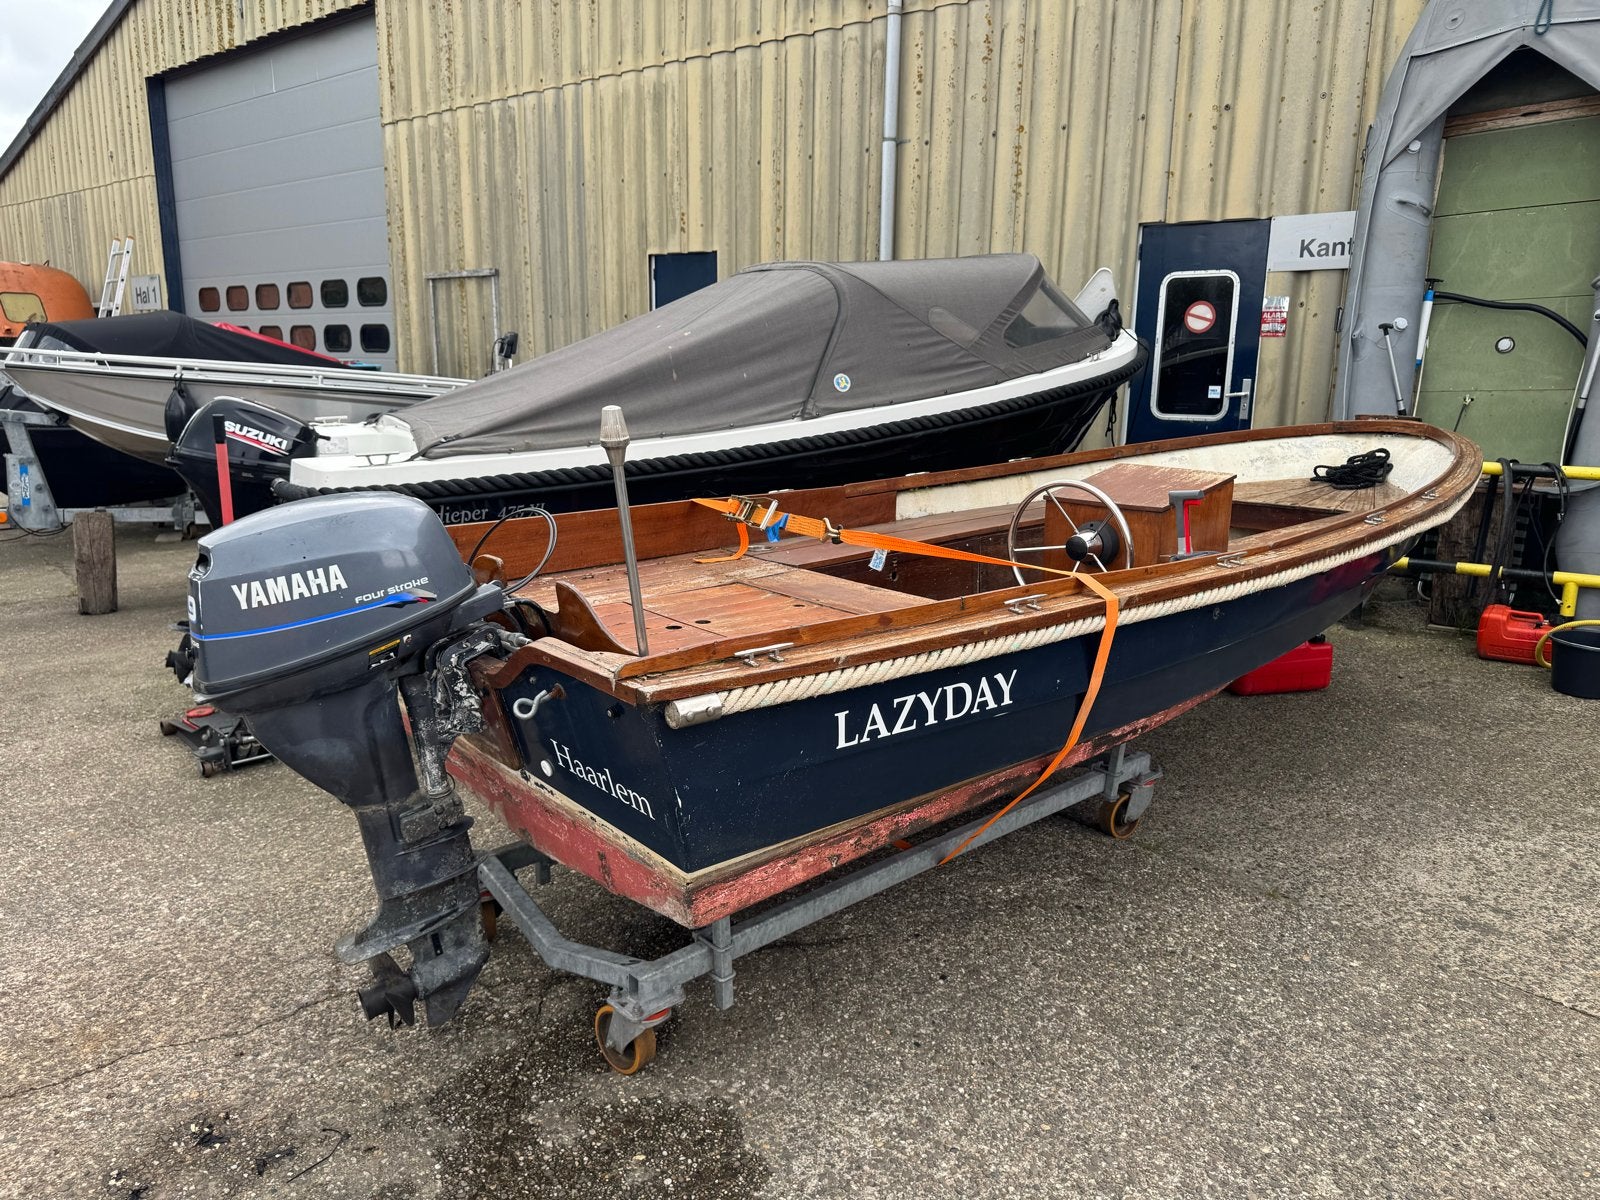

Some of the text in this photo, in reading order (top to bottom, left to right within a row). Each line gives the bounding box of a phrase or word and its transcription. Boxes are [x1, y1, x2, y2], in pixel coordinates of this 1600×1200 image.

[1299, 237, 1354, 258] Kant
[135, 286, 157, 304] Hal 1
[224, 420, 288, 450] SUZUKI
[231, 564, 349, 610] YAMAHA
[834, 669, 1018, 750] LAZYDAY
[550, 738, 656, 821] Haarlem
